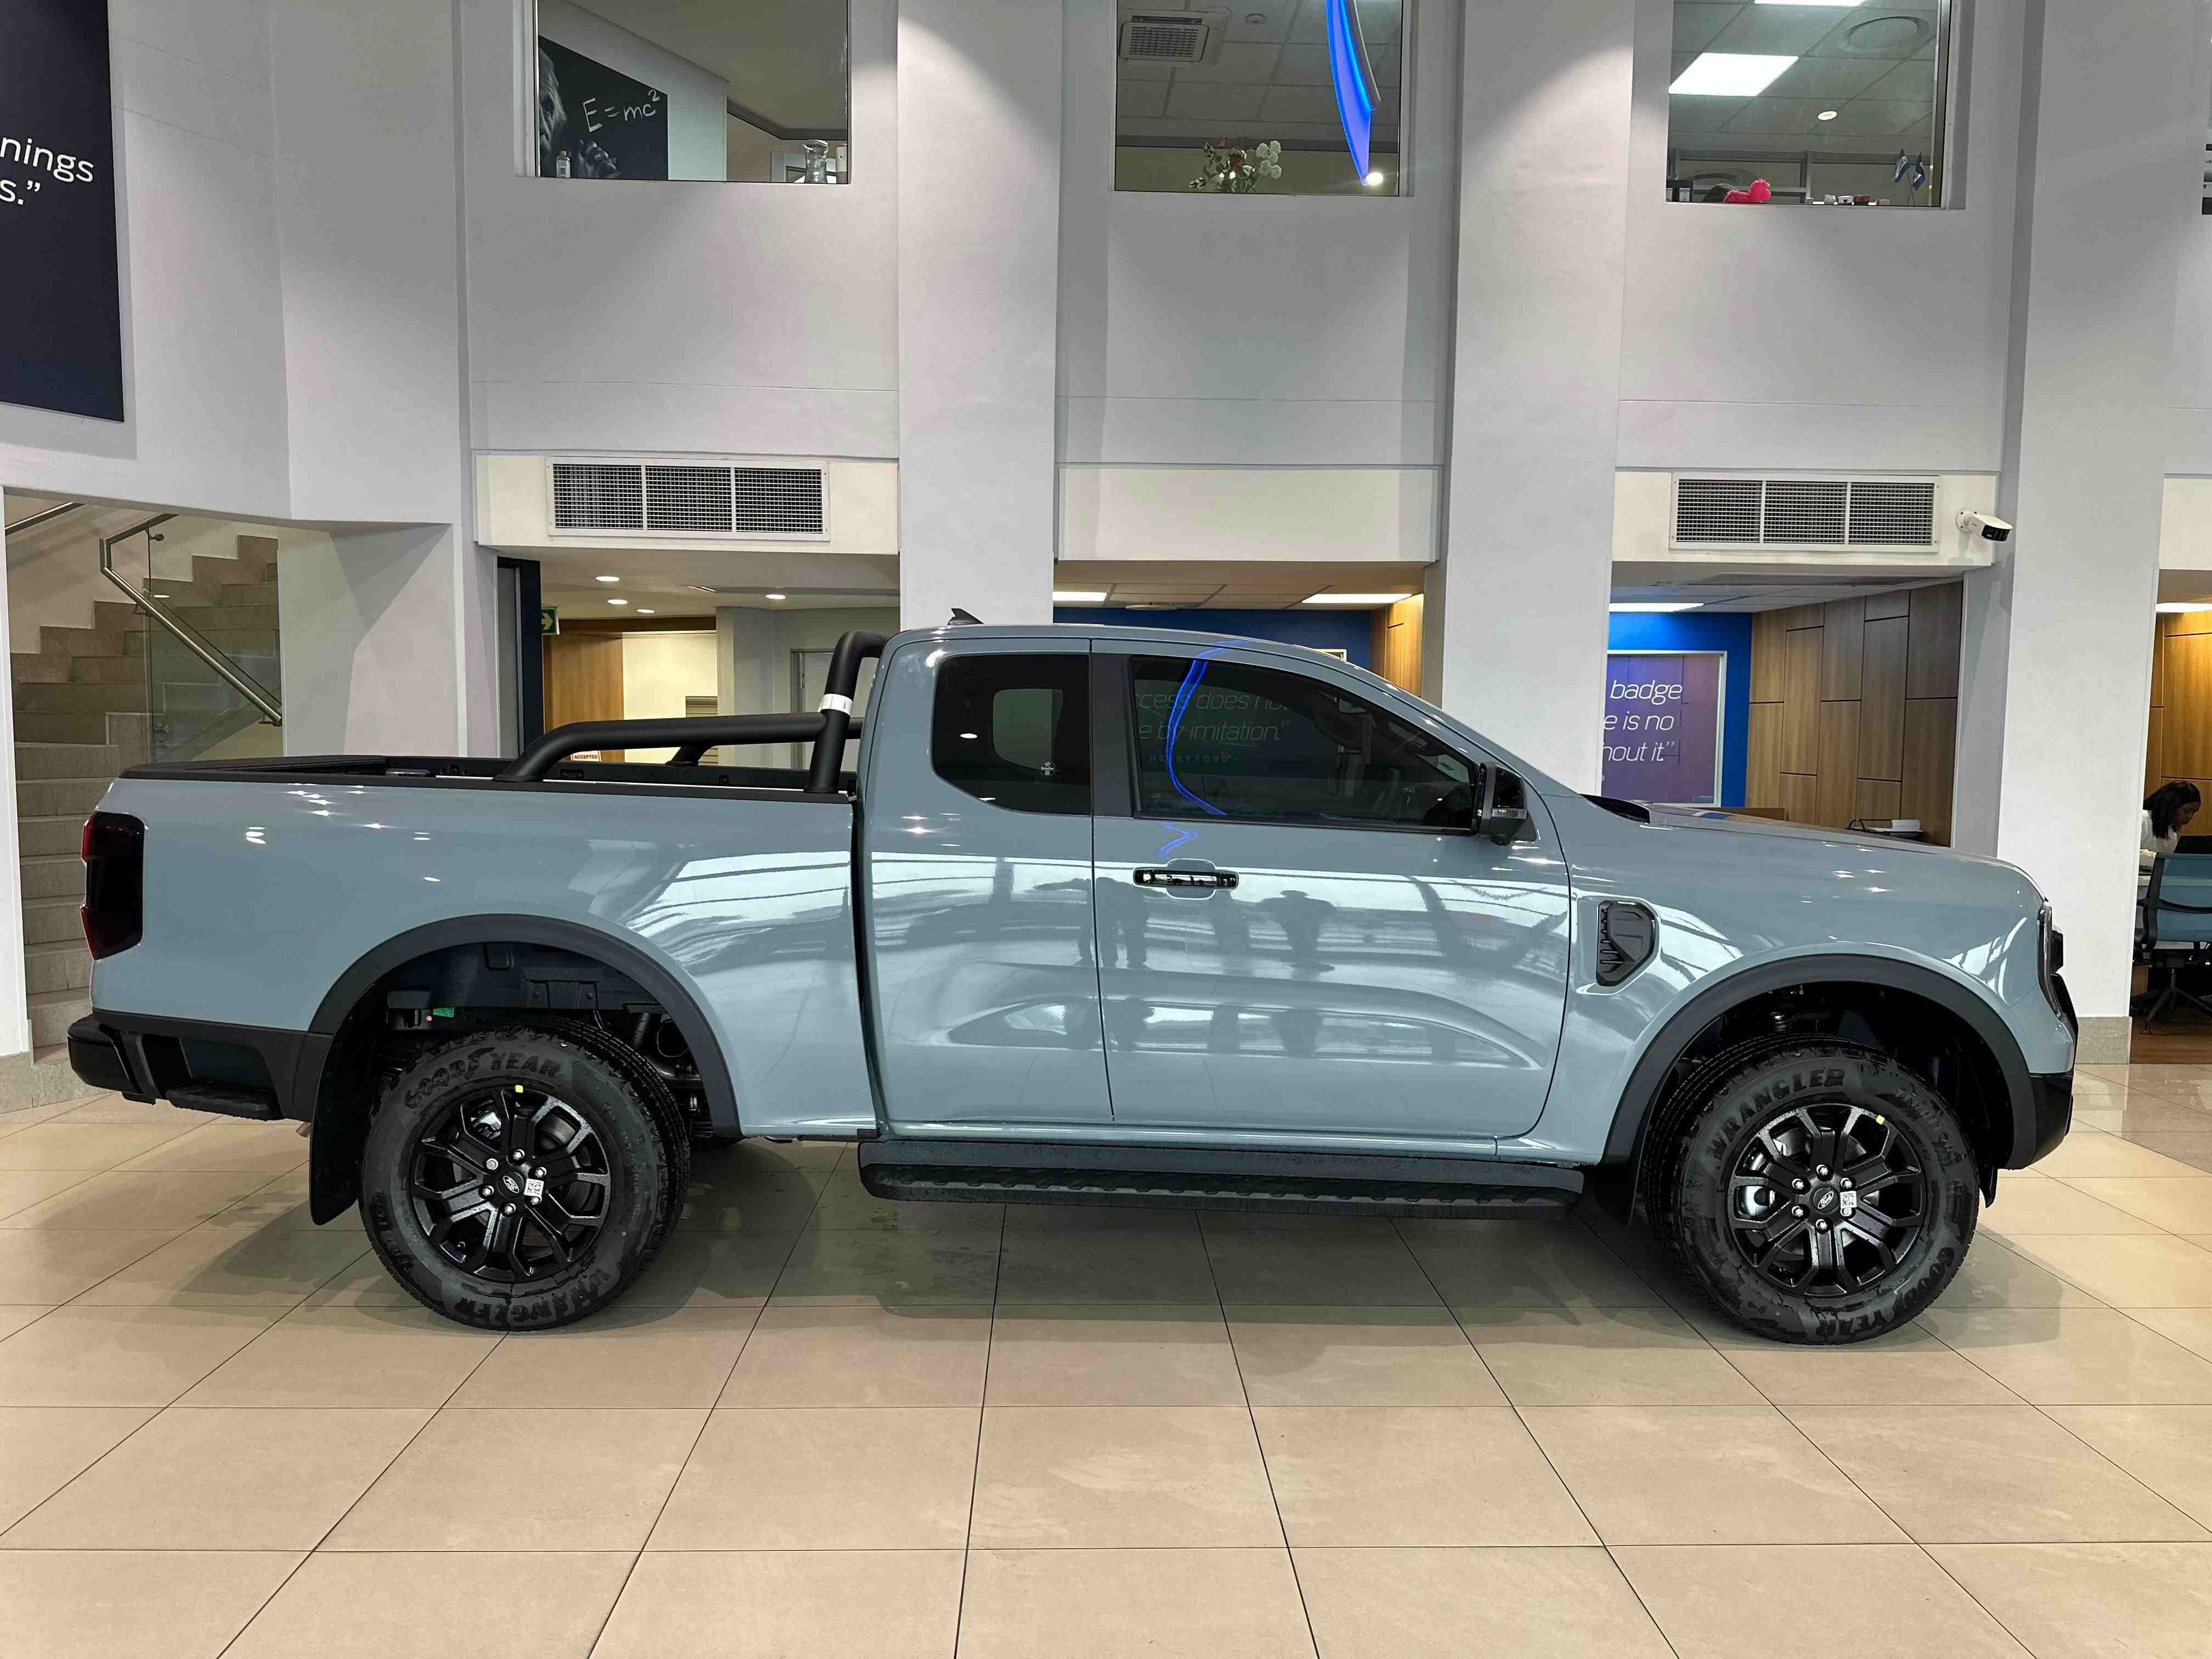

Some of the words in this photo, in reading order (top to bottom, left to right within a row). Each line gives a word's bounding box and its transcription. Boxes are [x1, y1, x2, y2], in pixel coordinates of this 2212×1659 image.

[0, 137, 94, 182] nings
[1196, 690, 1251, 710] does
[1610, 680, 1683, 705] badge
[1604, 715, 1618, 730] e
[1623, 711, 1640, 731] is
[1645, 715, 1674, 731] no
